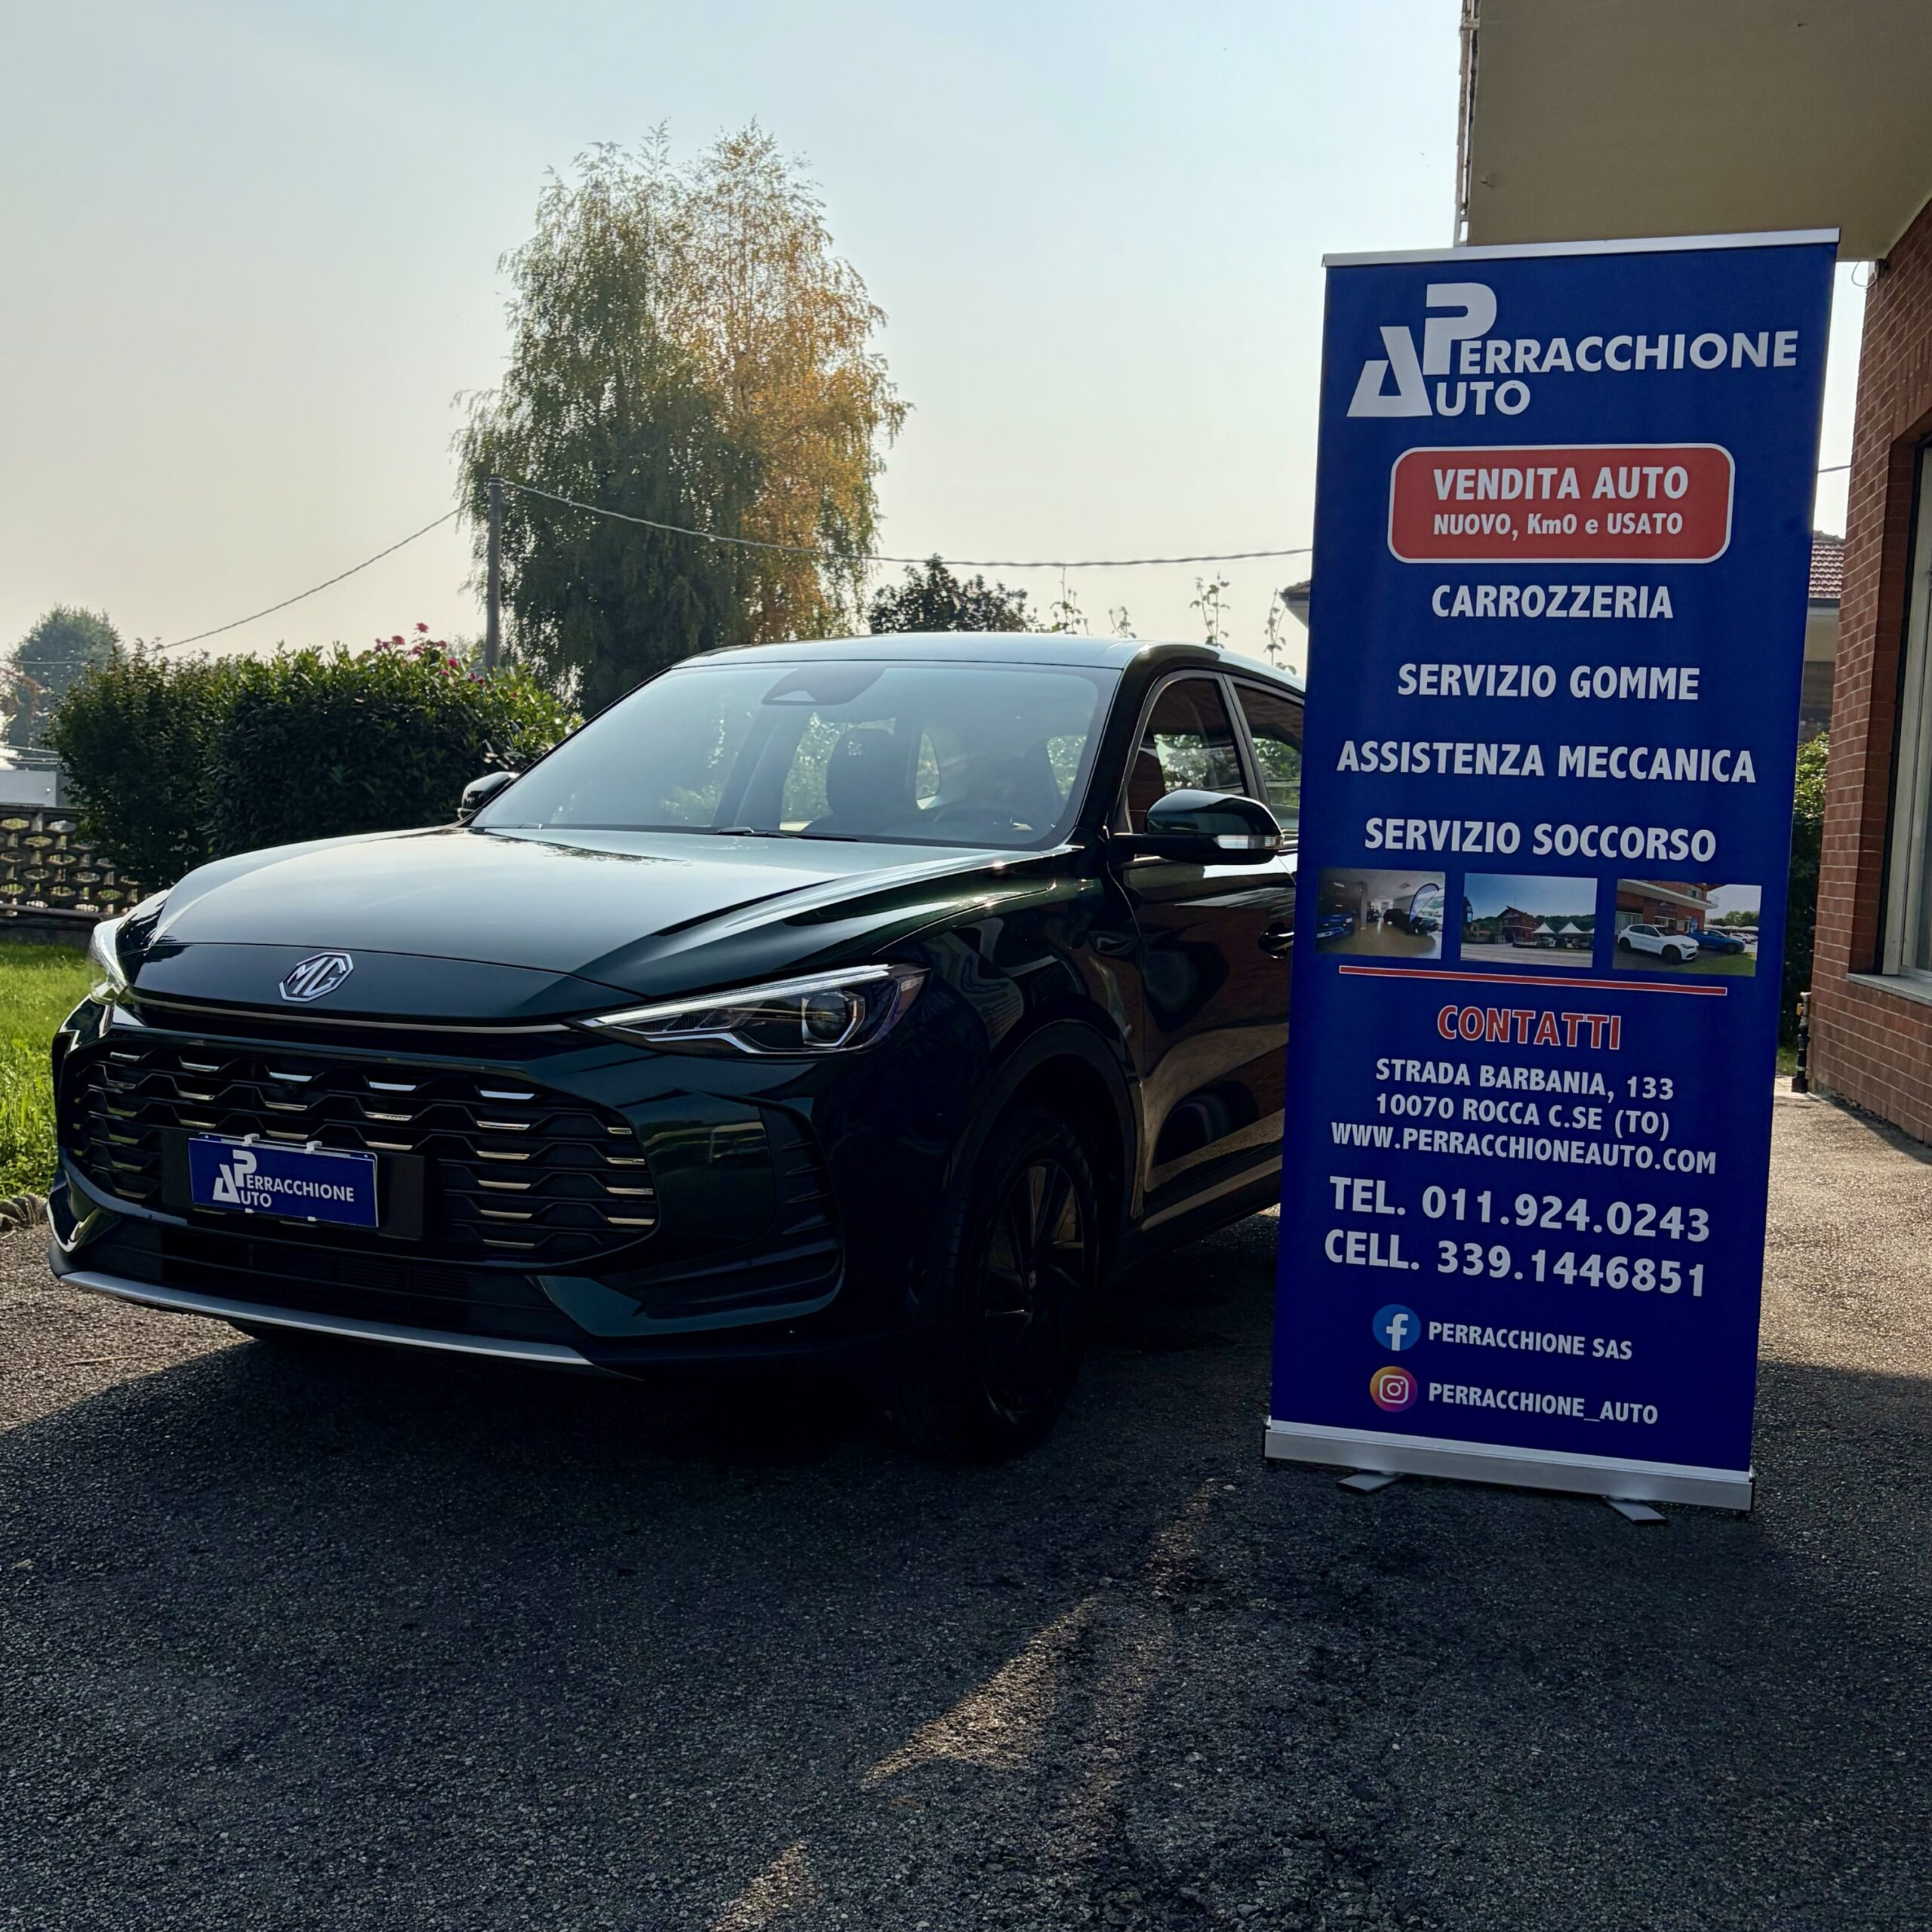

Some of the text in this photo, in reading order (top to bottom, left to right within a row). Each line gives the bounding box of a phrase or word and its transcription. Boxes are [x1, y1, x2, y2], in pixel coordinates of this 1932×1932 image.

[1423, 282, 1798, 375] PERRACCHIONE
[1346, 326, 1531, 417] AUTO
[1433, 466, 1688, 500] VENDITA AUTO
[1433, 512, 1518, 541] NUOVO,
[1585, 518, 1598, 534] e
[1607, 512, 1683, 534] USATO
[1432, 584, 1674, 619] CARROZZERIA
[1398, 663, 1700, 700] SERVIZIO GOMME
[1337, 740, 1756, 783] ASSISTENZA MECCANICA
[1364, 817, 1716, 862] SERVIZIO SOCCORSO
[285, 956, 347, 997] MG
[1437, 1004, 1622, 1051] CONTATTI
[1376, 1058, 1674, 1102] STRADA BARBANIA, 133
[1377, 1093, 1669, 1141] 10070 ROCCA C.SE (TO)
[1331, 1121, 1716, 1174] WWW.PERRACCHIONEAUTO.COM
[212, 1164, 272, 1208] AUTO
[232, 1149, 355, 1202] PERRACCHIONE
[1330, 1176, 1709, 1242] TEL. 011.924.0243
[1324, 1229, 1704, 1297] CELL. 339.1446851
[1429, 1321, 1632, 1360] PERRACCHIONE SAS
[1429, 1383, 1658, 1424] PERRACCHIONE_AUTO
